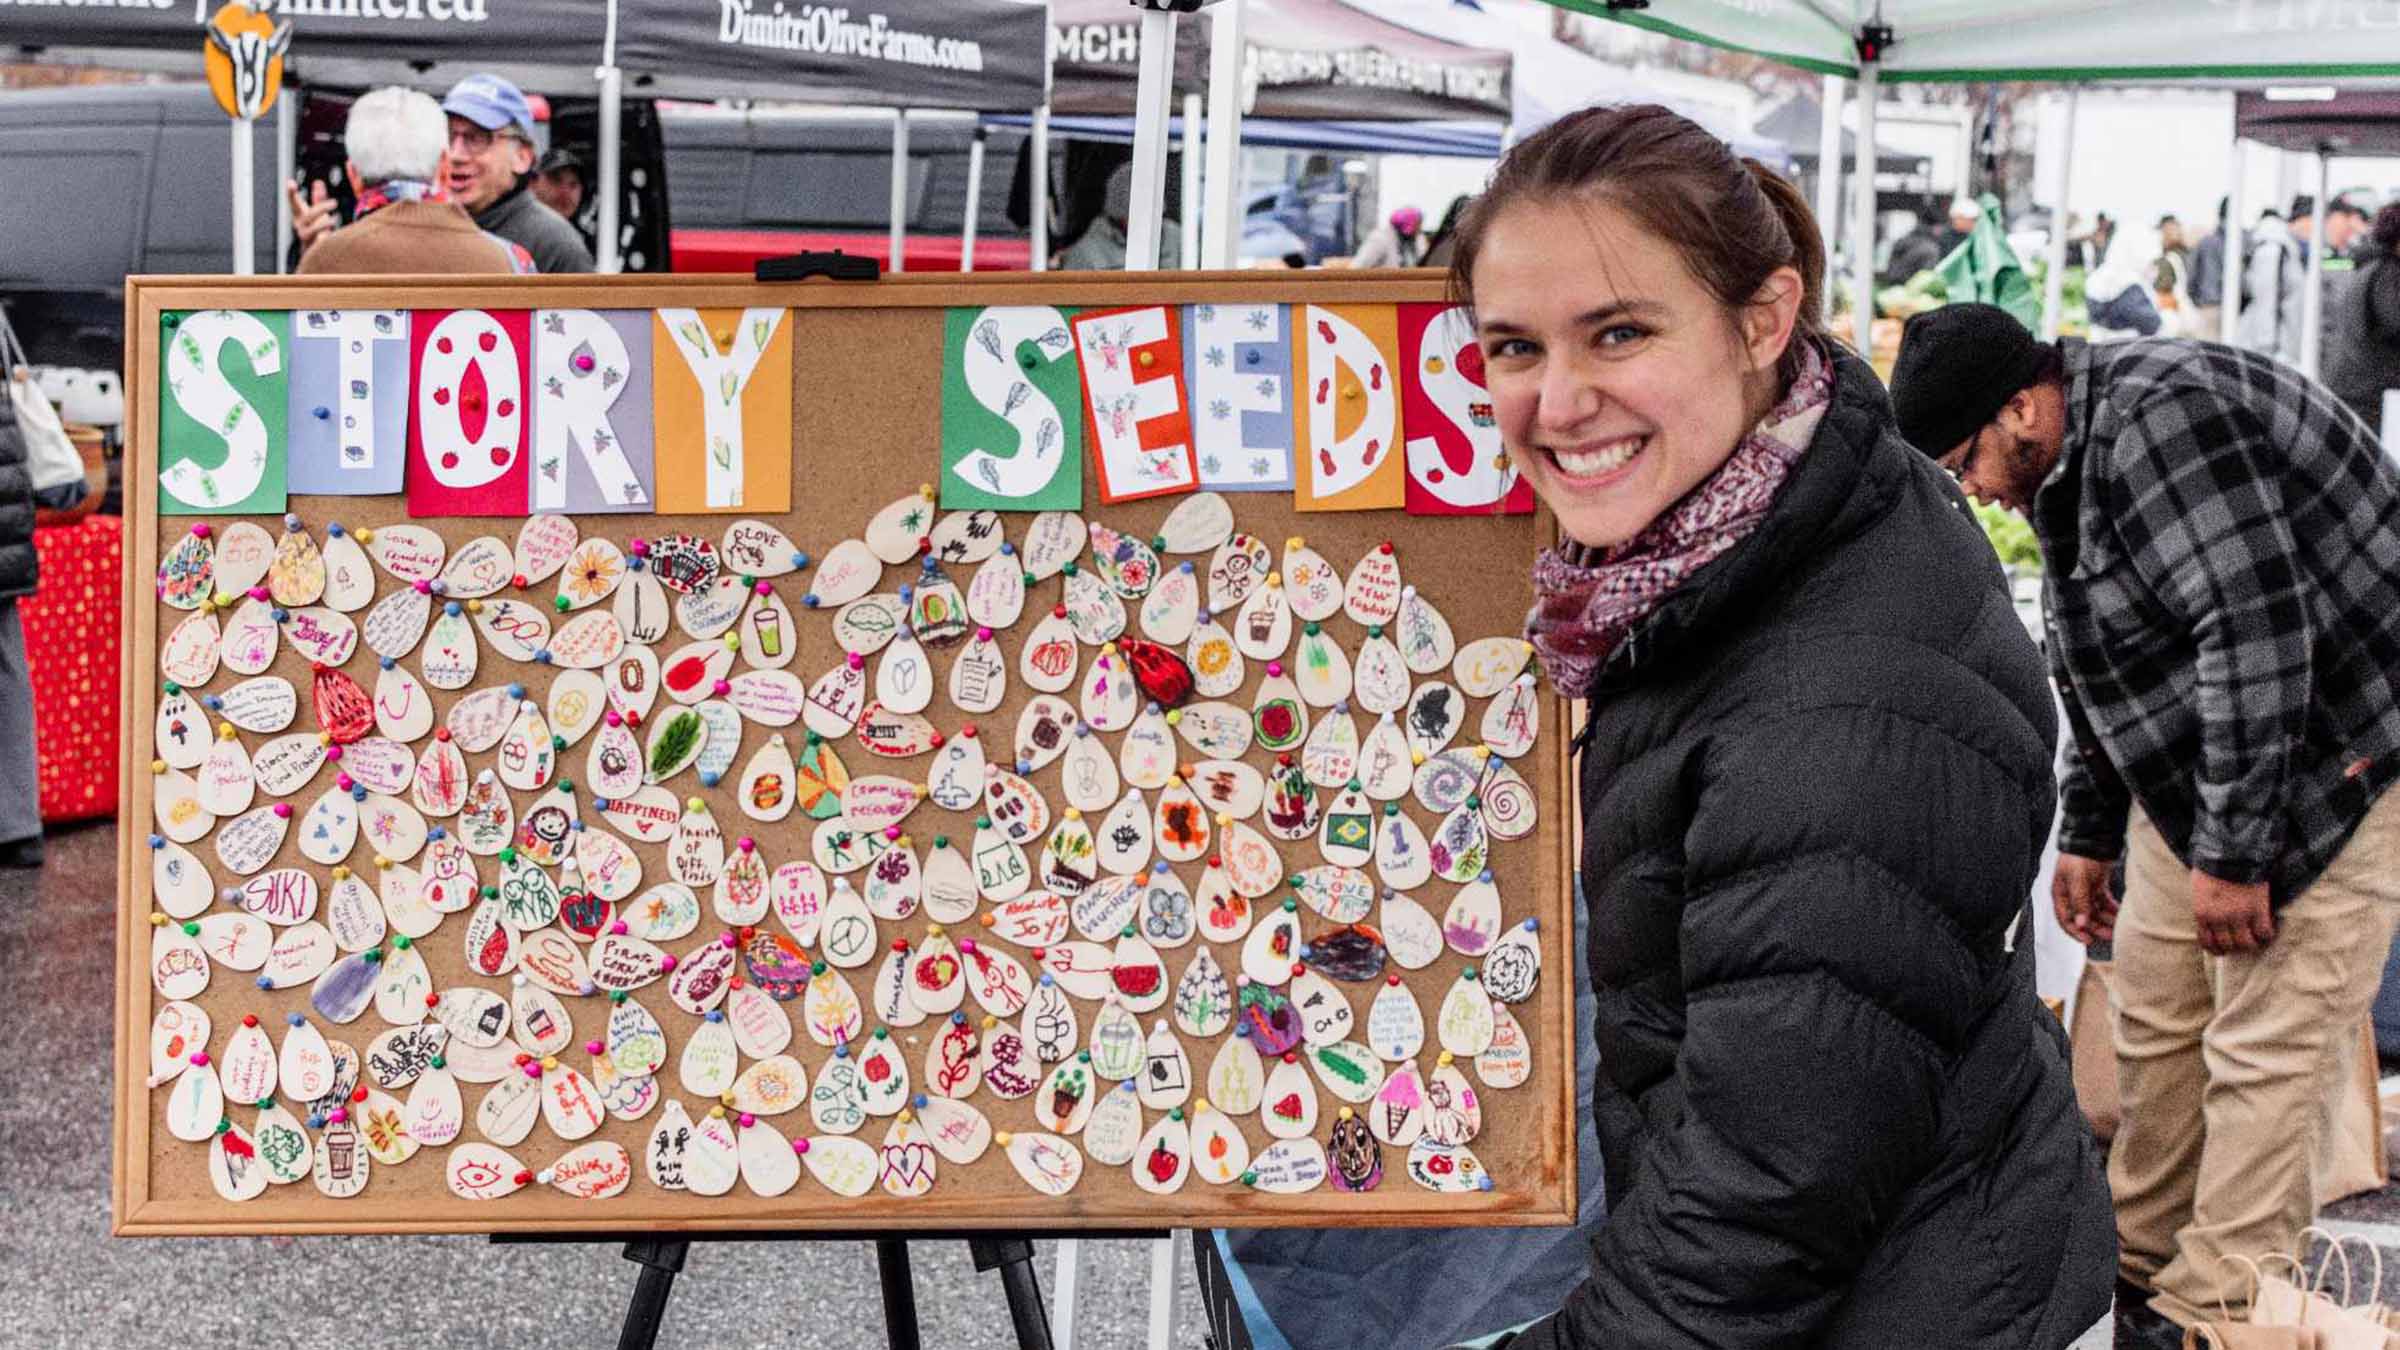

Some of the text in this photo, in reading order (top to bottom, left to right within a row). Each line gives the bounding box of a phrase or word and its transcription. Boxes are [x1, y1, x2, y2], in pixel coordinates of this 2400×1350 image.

[719, 0, 983, 71] DimitriOliveFarms.com
[159, 303, 1518, 508] STORY SEEDS
[246, 870, 307, 920] SUKI
